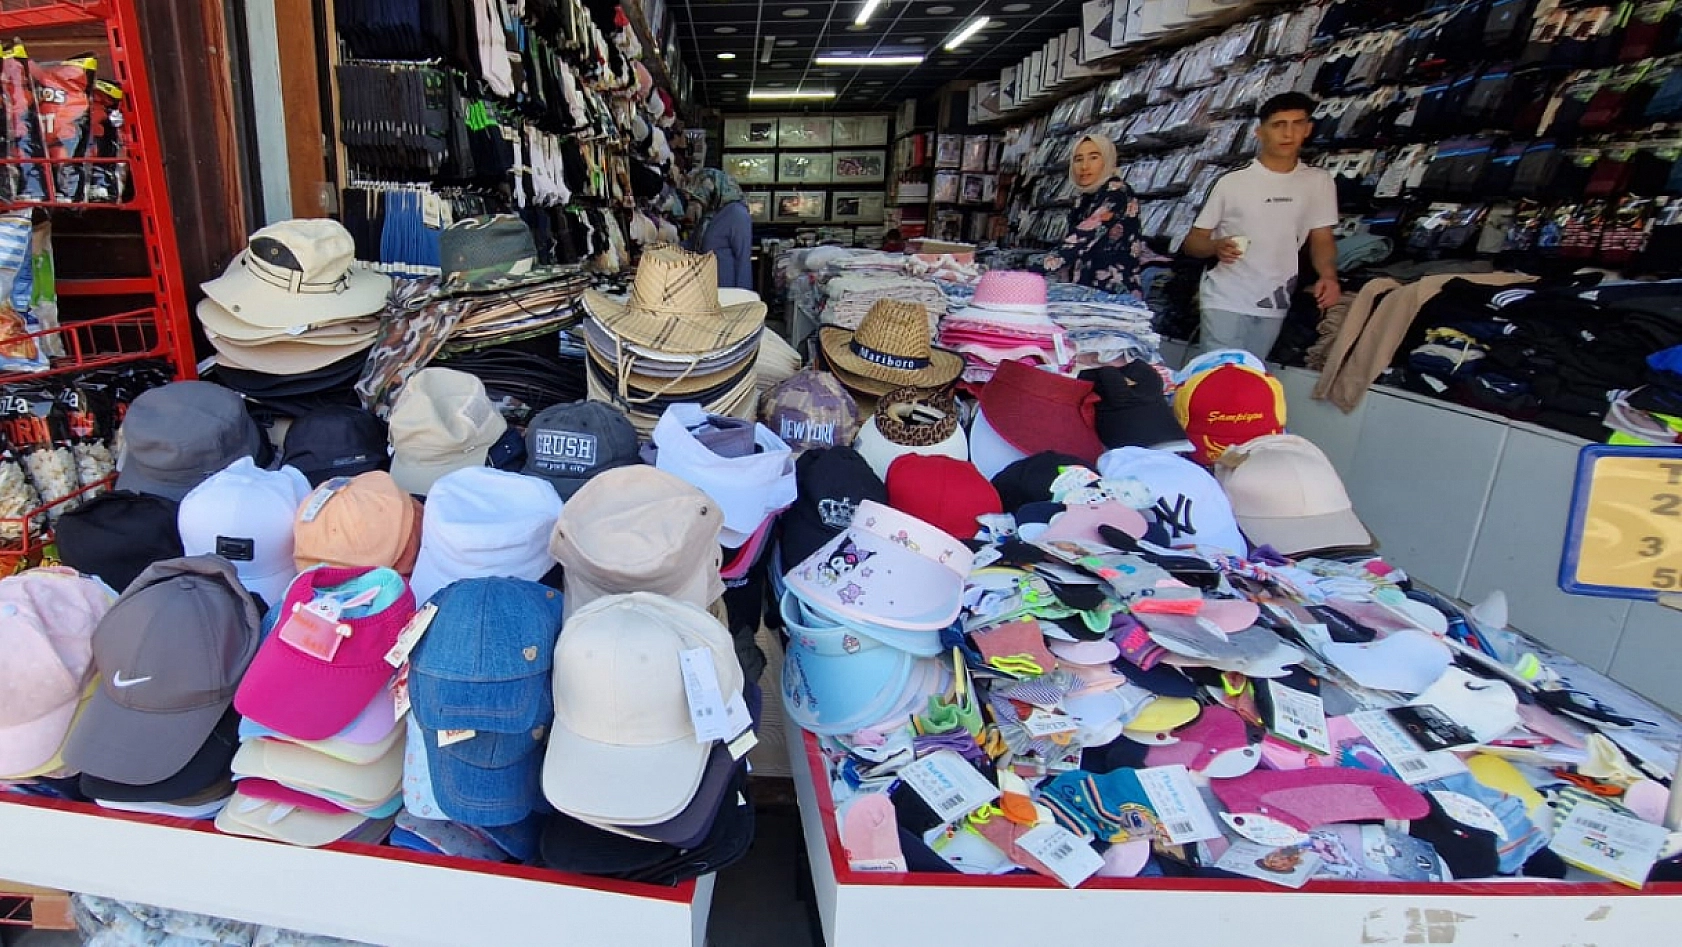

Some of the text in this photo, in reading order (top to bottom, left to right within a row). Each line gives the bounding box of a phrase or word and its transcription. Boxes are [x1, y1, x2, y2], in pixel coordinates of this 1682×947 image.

[806, 416, 836, 446] YORK
[1638, 535, 1665, 558] 3
[1652, 567, 1682, 589] 5
